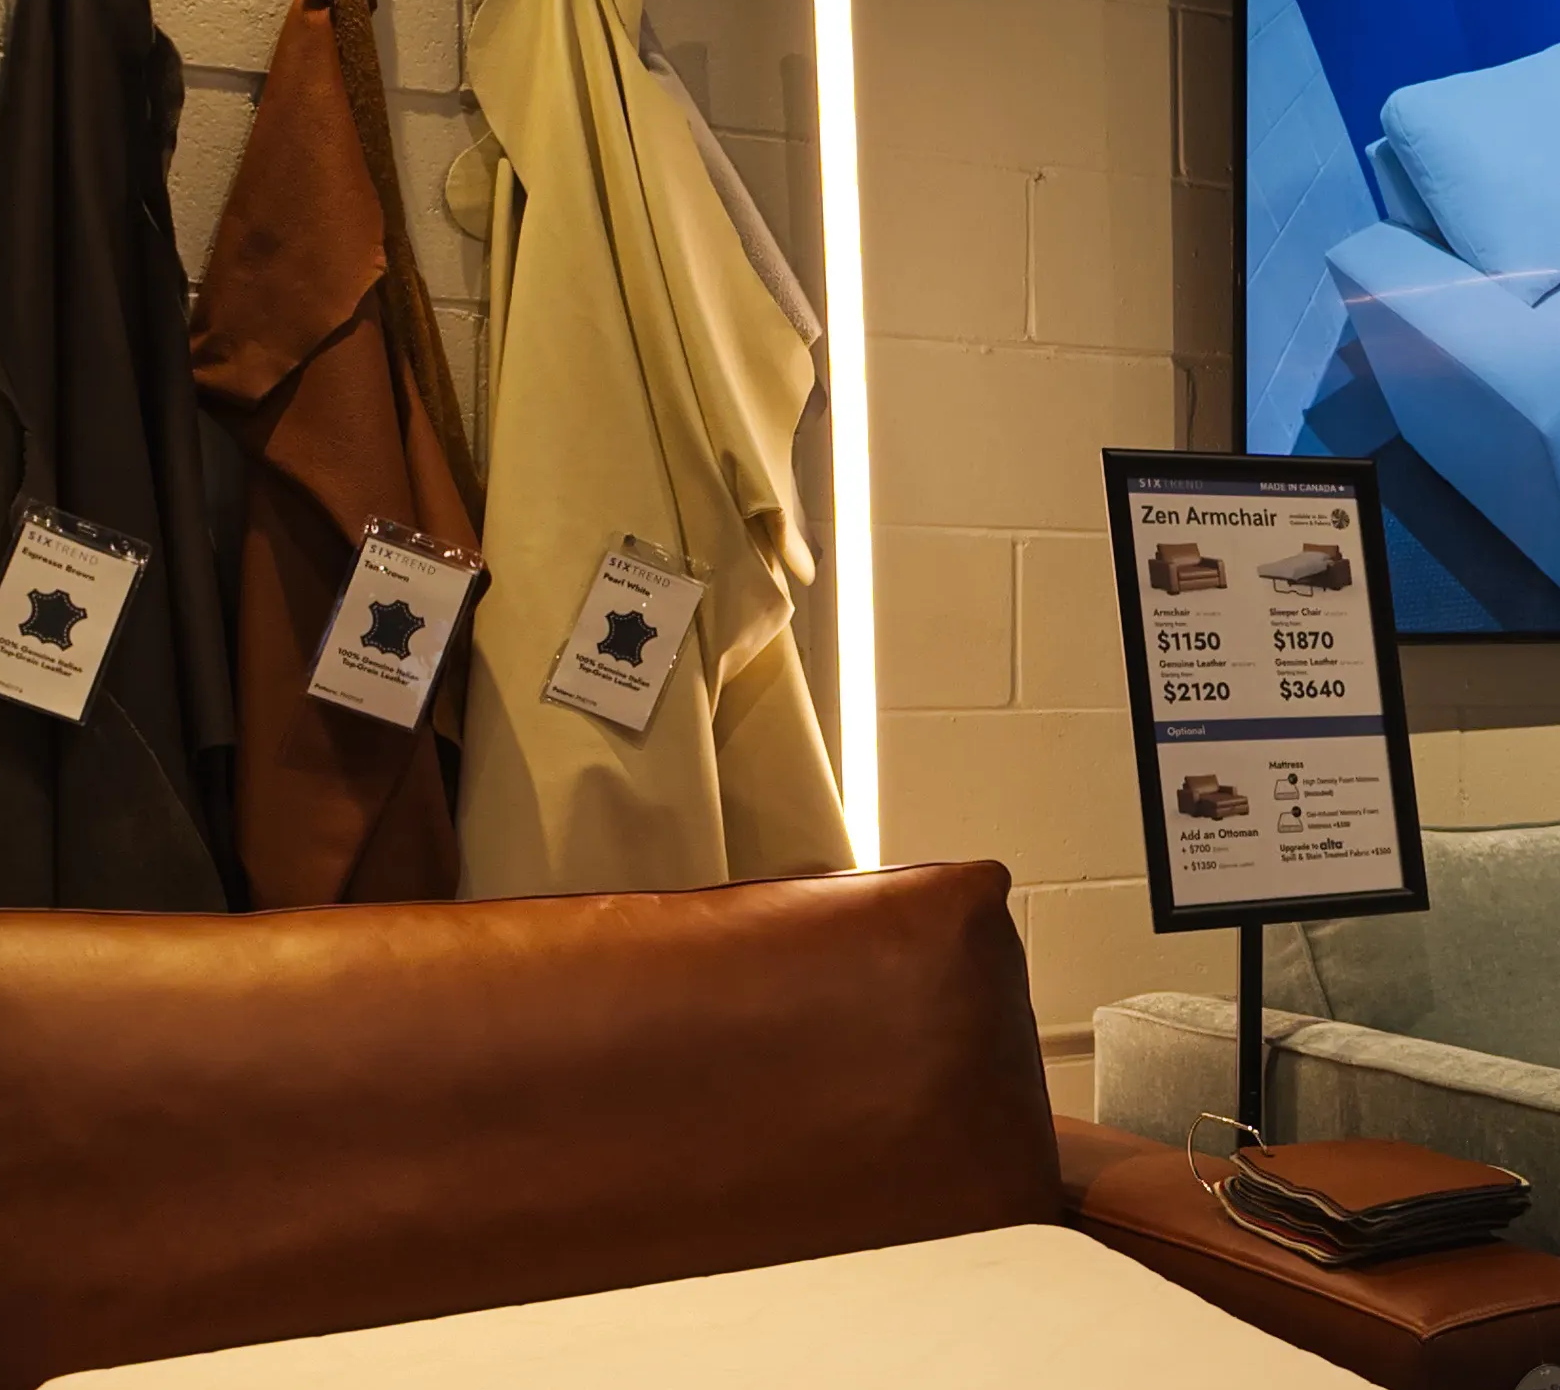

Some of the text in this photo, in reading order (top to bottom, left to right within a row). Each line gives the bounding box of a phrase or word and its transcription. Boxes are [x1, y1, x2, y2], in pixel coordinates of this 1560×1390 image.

[1260, 482, 1336, 493] MADE IN CANADA
[1141, 505, 1180, 525] Zen
[1186, 506, 1277, 527] Armchair
[27, 530, 99, 566] SIXTREND
[22, 546, 95, 582] Espresso Brown
[369, 544, 436, 576] SIXTREND
[364, 560, 410, 583] Tan rown
[608, 557, 671, 588] SIXTREND
[603, 572, 651, 597] Pearl White
[1153, 608, 1190, 616] Armchair
[1301, 608, 1321, 616] Chair
[1157, 629, 1221, 653] $1150
[1273, 629, 1334, 652] $1870
[338, 647, 360, 662] 100%
[361, 656, 394, 673] Genuine
[576, 653, 596, 668] 100%
[598, 662, 627, 679] Genuine
[1159, 659, 1194, 669] Genuine
[1196, 658, 1227, 668] Leather
[1275, 658, 1308, 666] Genuine
[1309, 658, 1337, 666] Leather
[380, 670, 410, 686] Leather
[614, 676, 641, 691] Leather
[1164, 680, 1230, 704] $2120
[1280, 677, 1345, 701] $3640
[1167, 724, 1206, 738] Optional
[1269, 761, 1304, 770] Mattress
[1180, 828, 1259, 841] Add an Ottoman
[1189, 844, 1211, 854] $700
[1280, 843, 1310, 853] Upgrade
[1320, 837, 1343, 851] alta
[1191, 861, 1217, 872] $1350
